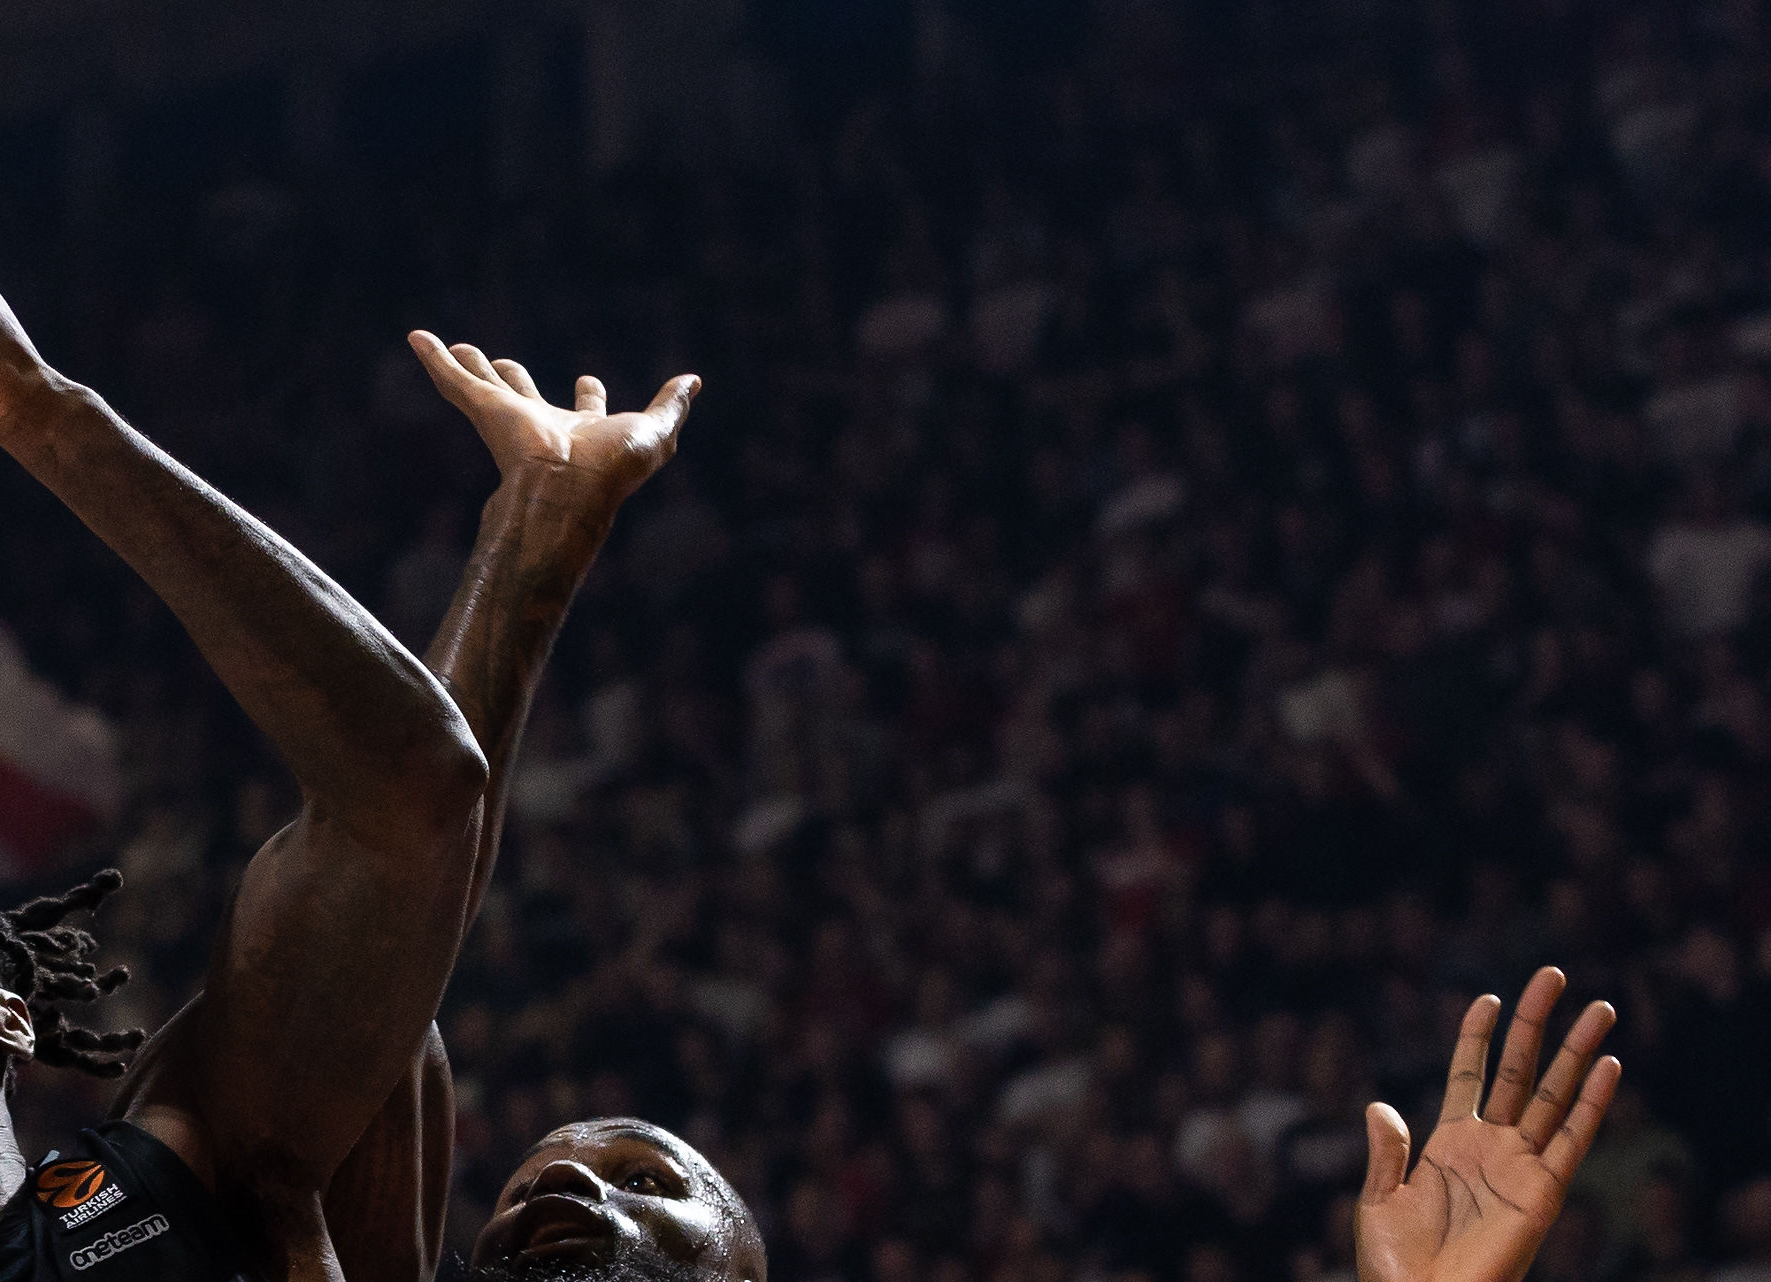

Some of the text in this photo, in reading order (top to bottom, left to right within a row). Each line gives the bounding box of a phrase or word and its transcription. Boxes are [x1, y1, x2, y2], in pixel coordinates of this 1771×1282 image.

[59, 1183, 119, 1223] TURKISH
[66, 1190, 124, 1228] AIRLINES
[69, 1213, 170, 1271] oneteam
